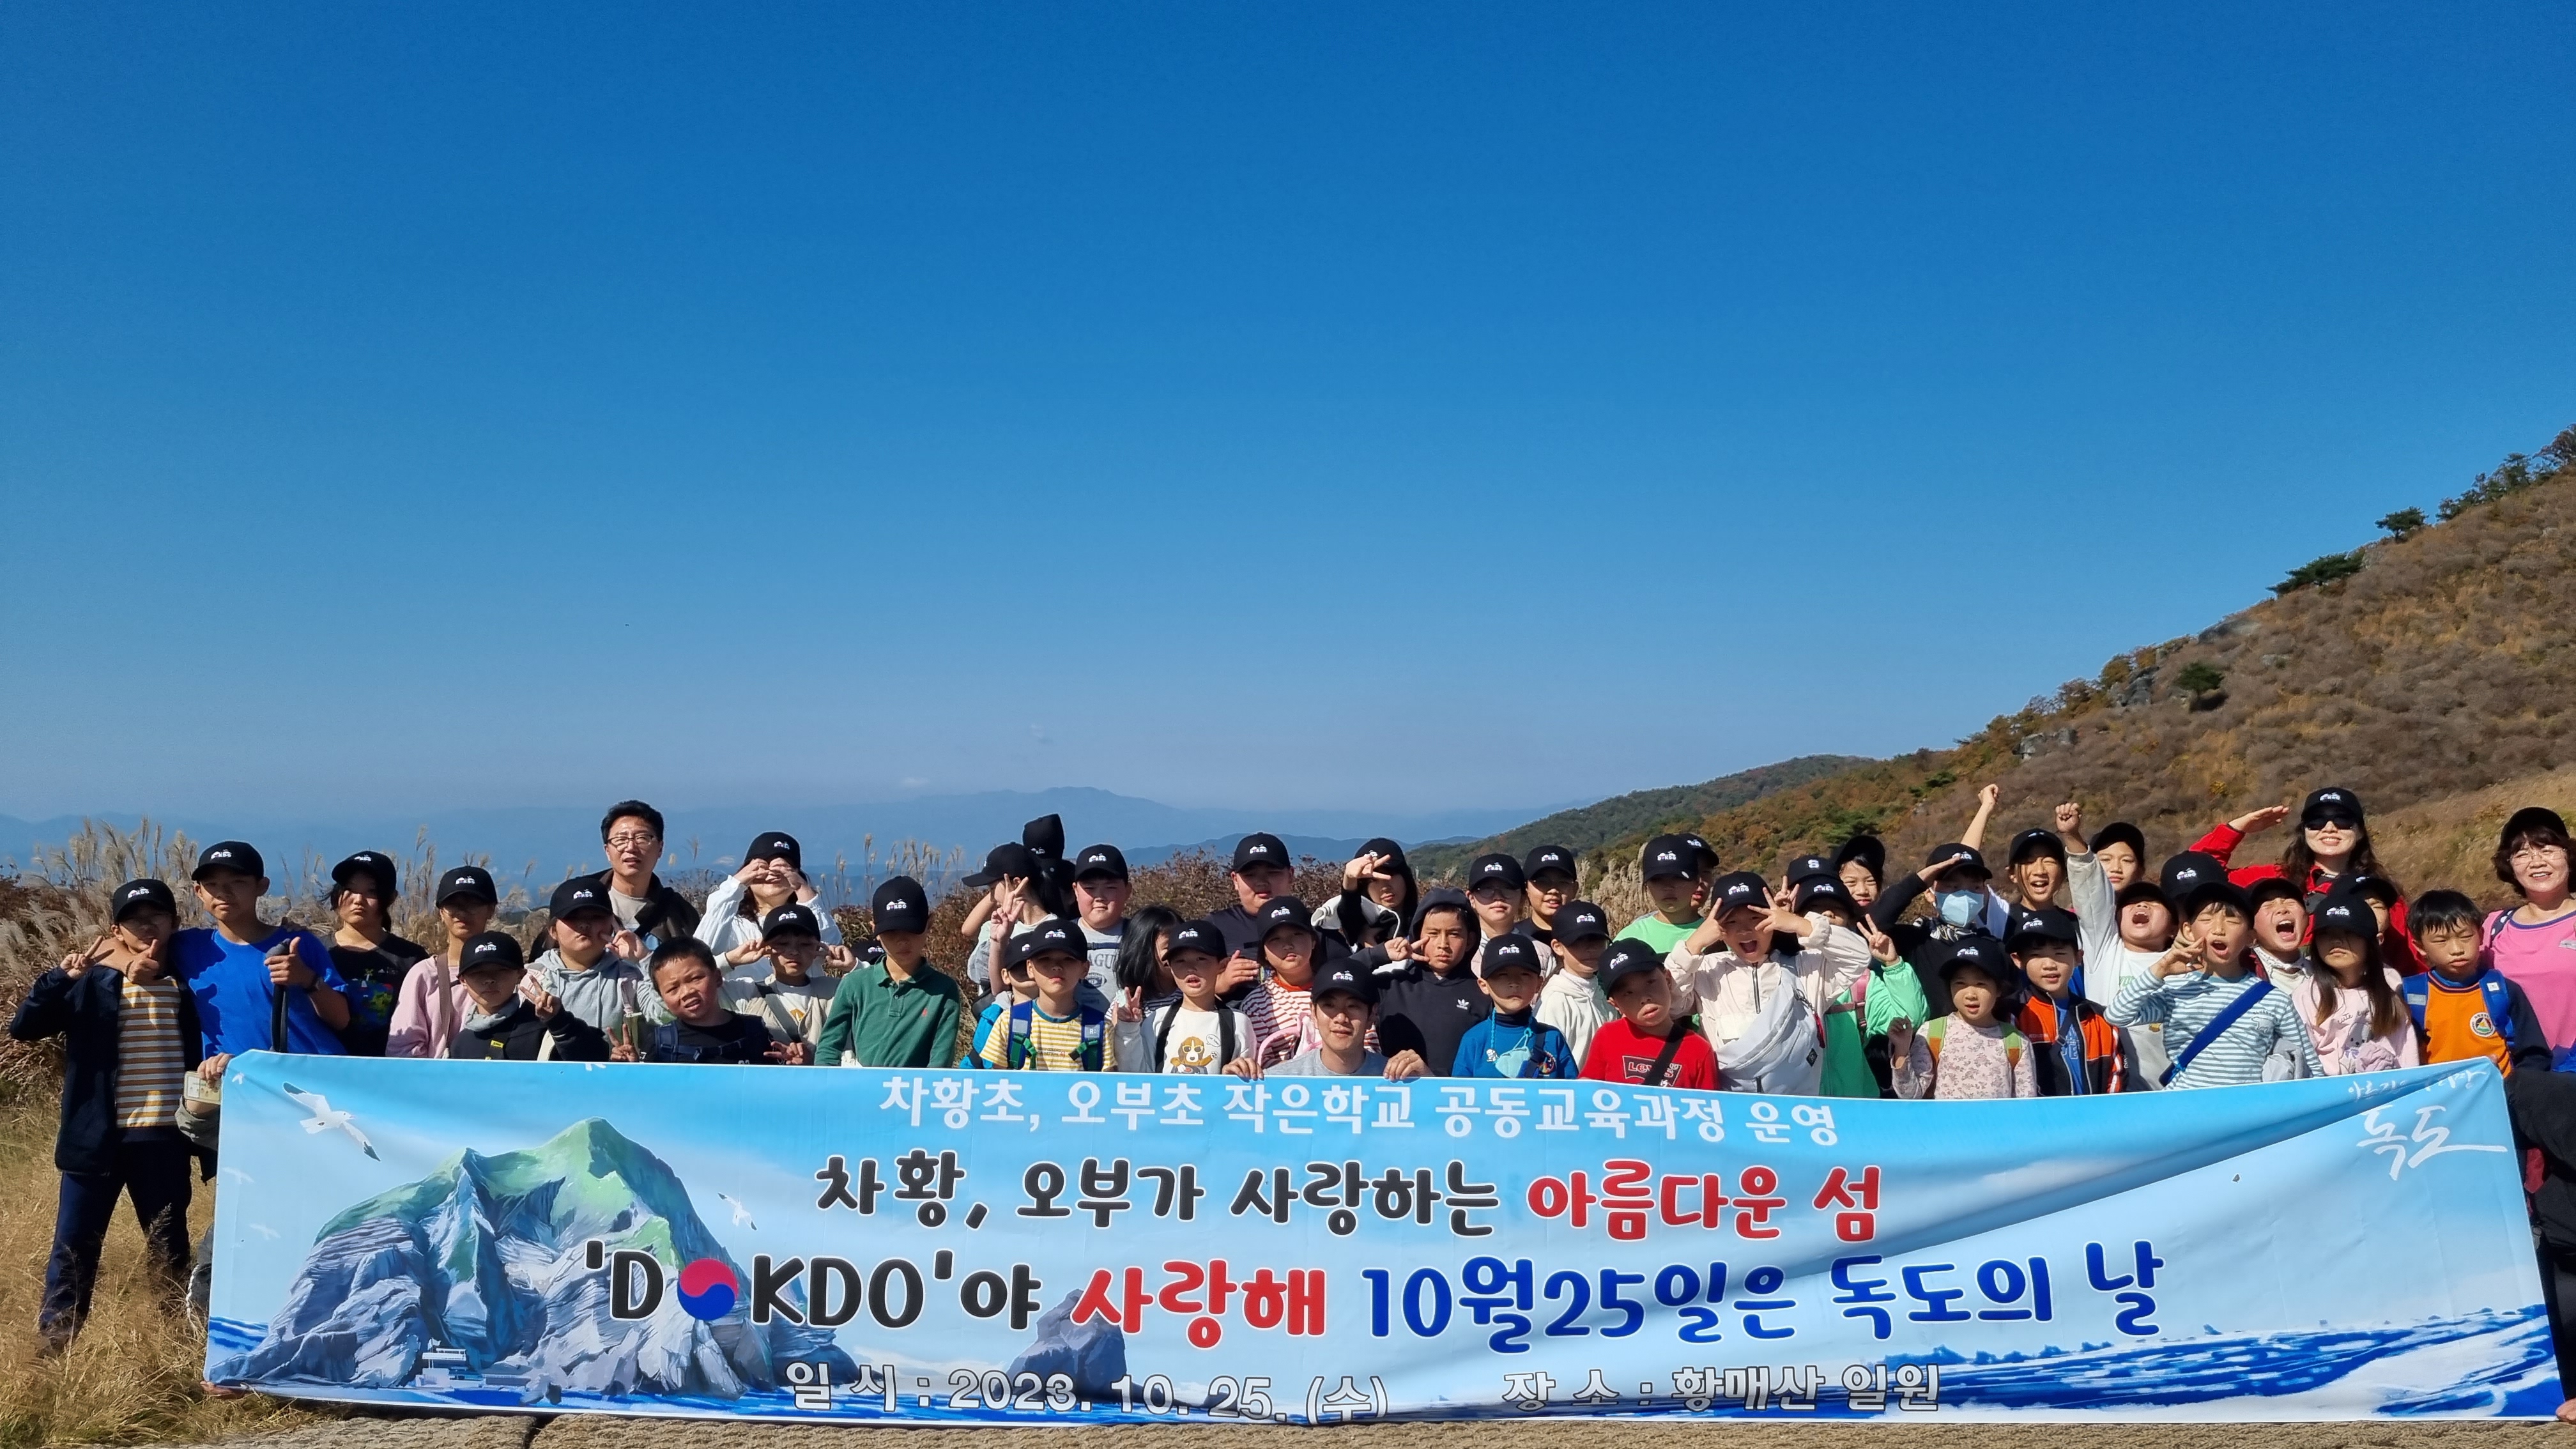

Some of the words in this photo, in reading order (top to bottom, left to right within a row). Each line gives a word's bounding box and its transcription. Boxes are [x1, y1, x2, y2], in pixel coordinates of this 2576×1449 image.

[880, 1077, 1040, 1132] 차황초,
[1061, 1081, 1204, 1130] 오부초
[1223, 1084, 1414, 1135] 작은학교
[1436, 1085, 1725, 1143] 공동교육과정
[1745, 1102, 1837, 1146] 운영
[2356, 1105, 2508, 1181] 독도
[814, 1149, 990, 1230] 차황,
[1017, 1158, 1206, 1228] 오부가
[1229, 1160, 1499, 1237] 사랑하는
[1527, 1158, 1787, 1241] 아름다운
[1812, 1165, 1882, 1243] 섬
[1071, 1259, 1327, 1349] 사랑해
[1361, 1255, 1797, 1355] 10월25일은
[1830, 1254, 2053, 1340] 독도의
[2086, 1239, 2164, 1335] 날
[948, 1368, 1092, 1413] 2023.
[1111, 1374, 1189, 1415] 10.
[1208, 1376, 1287, 1422] 25.
[1305, 1376, 1388, 1425] (수)
[1671, 1365, 1825, 1411] 황매산
[1841, 1363, 1938, 1411] 일원
